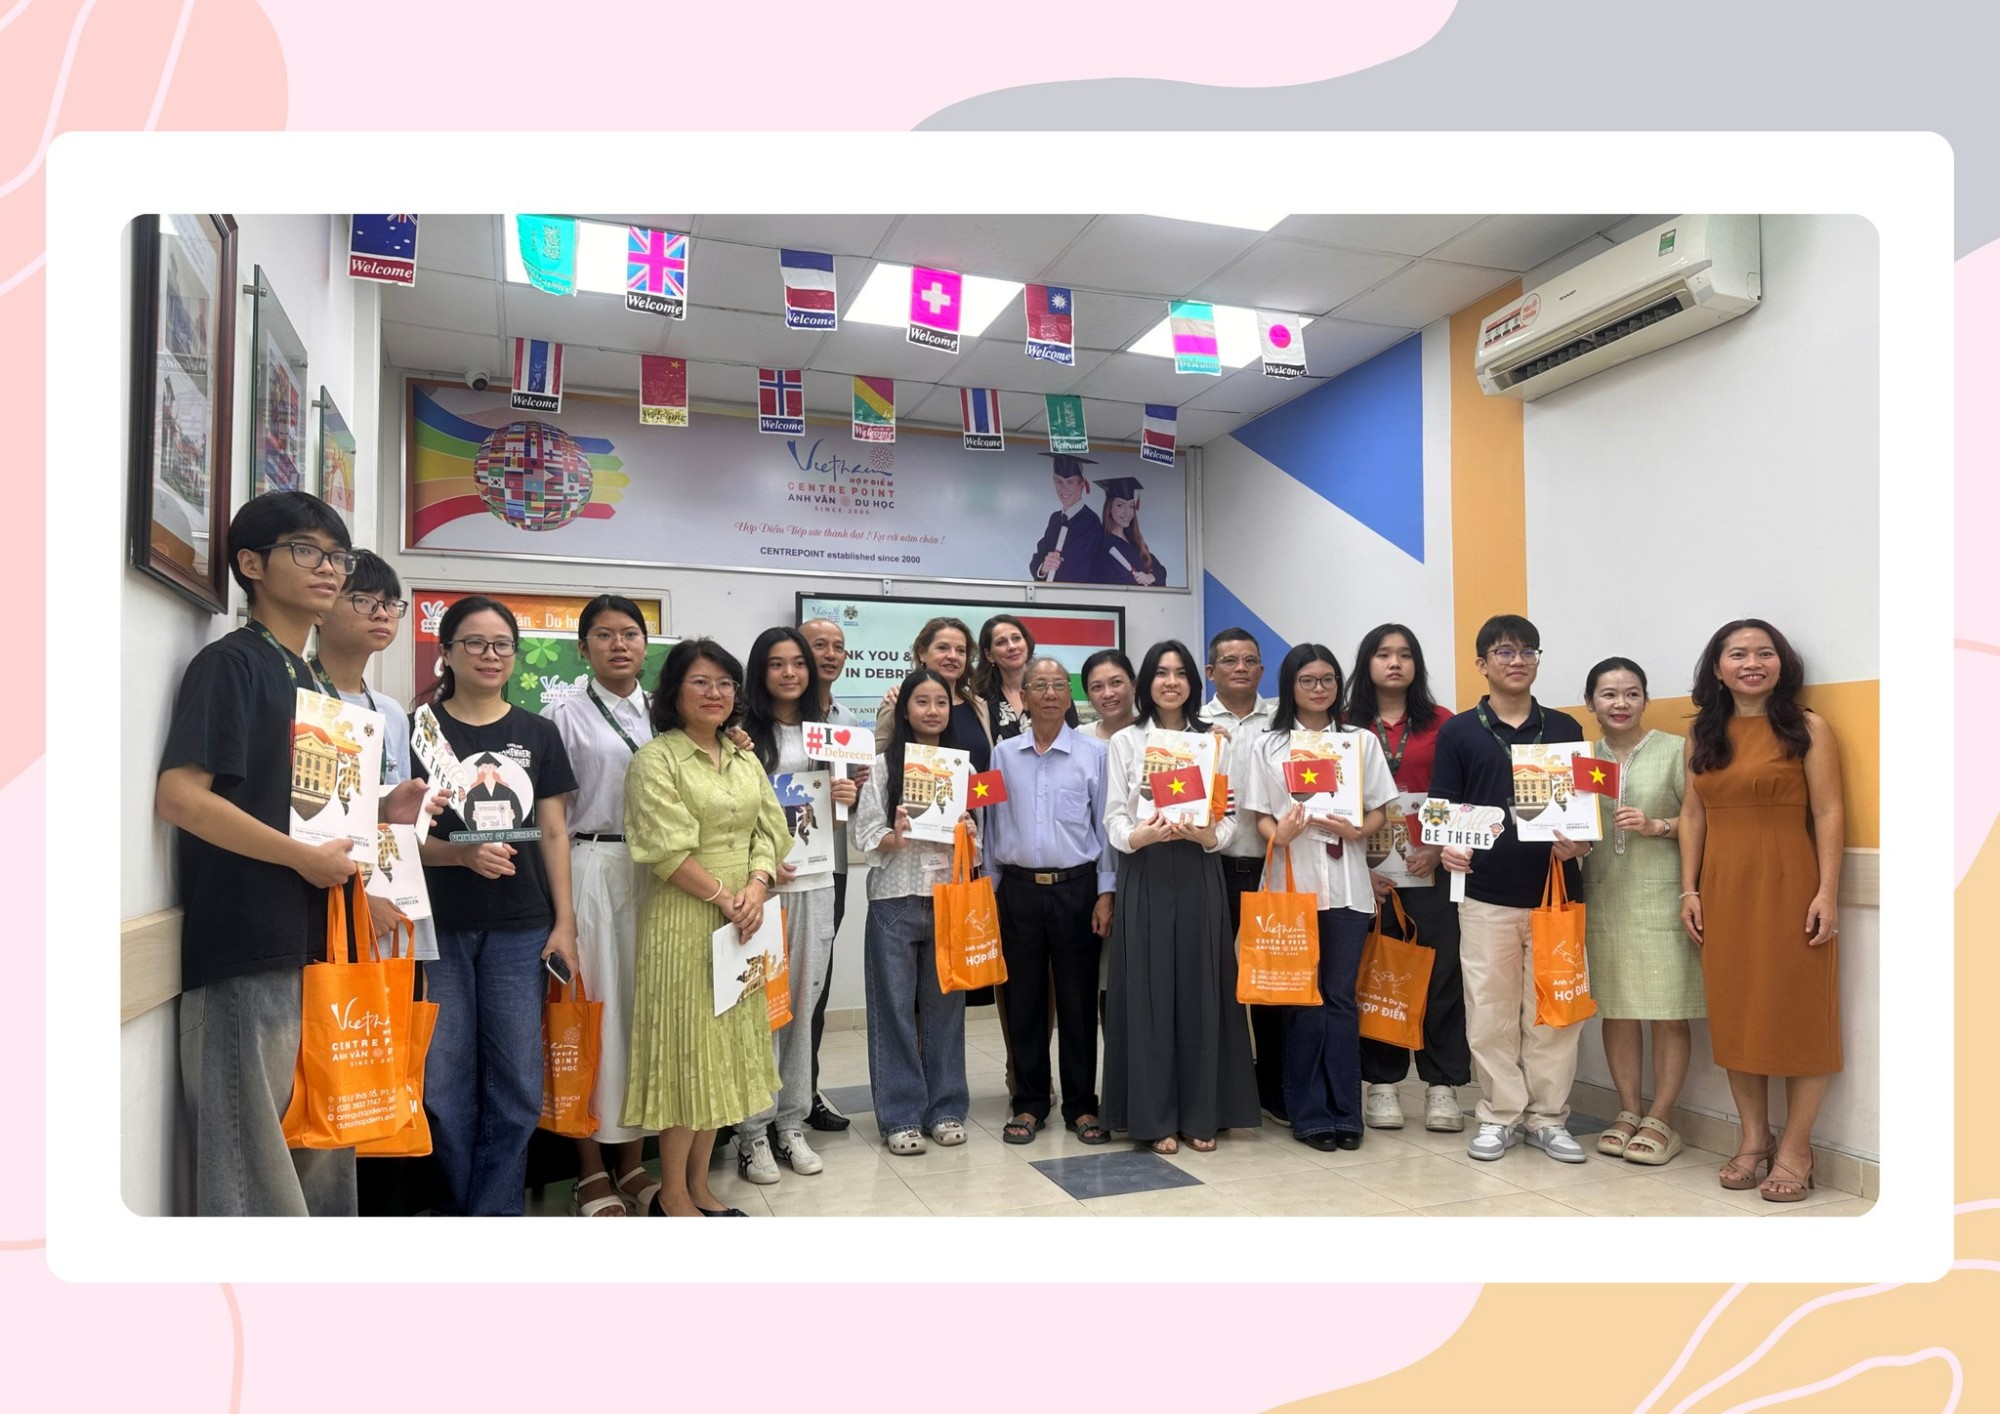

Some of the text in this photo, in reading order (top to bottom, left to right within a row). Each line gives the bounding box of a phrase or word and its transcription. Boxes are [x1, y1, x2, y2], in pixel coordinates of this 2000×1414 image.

[351, 259, 413, 279] Welcome
[627, 294, 684, 316] Welcome
[910, 327, 957, 349] Welcome
[1027, 344, 1072, 362] Welcome
[512, 394, 558, 410] Welcome
[762, 419, 804, 432] Welcome
[854, 425, 893, 440] Welcome
[966, 436, 1002, 448] Welcome
[1053, 440, 1087, 450] Welcome
[1143, 448, 1174, 462] Welcome
[788, 482, 895, 498] CENTRE POINT
[788, 494, 895, 509] ANH VĂN DU HỌC
[760, 546, 921, 564] CENTREPOINT established since 2000
[545, 613, 562, 628] Du
[868, 650, 899, 662] YOU
[845, 667, 860, 678] IN
[825, 748, 873, 761] Debrecen
[415, 734, 458, 805] BE THERE
[1424, 829, 1490, 846] BE THERE
[966, 954, 987, 967] HỢP
[1554, 988, 1574, 1003] HỢ
